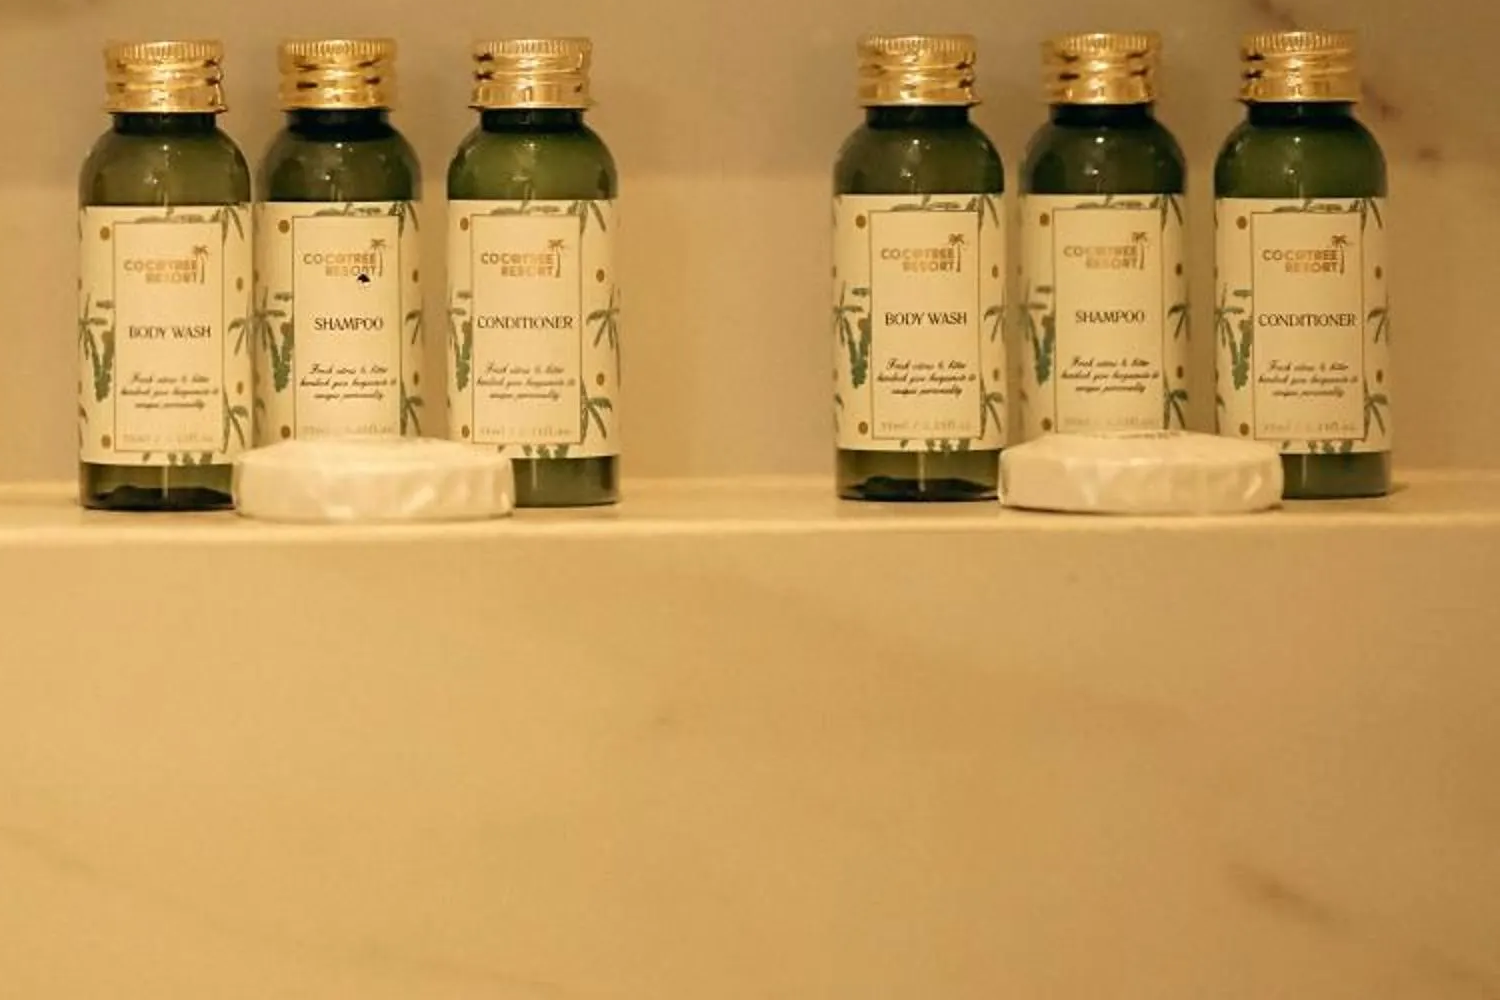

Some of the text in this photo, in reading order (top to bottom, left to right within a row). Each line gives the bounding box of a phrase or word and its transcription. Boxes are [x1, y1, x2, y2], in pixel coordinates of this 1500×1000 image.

[303, 252, 377, 265] COCOTREE
[480, 252, 554, 265] COCOTREE
[881, 248, 954, 260] COCOTREE
[1262, 249, 1338, 261] COCOTREE
[902, 261, 955, 272] RESORT
[1285, 261, 1338, 273] RESORT
[313, 316, 384, 331] SHAMPOO
[477, 315, 573, 329] CONDITIONER
[885, 311, 967, 326] BODY WASH
[1075, 310, 1145, 324] SHAMPOO
[1258, 313, 1357, 327] CONDITIONER
[129, 325, 211, 339] BODY WASH
